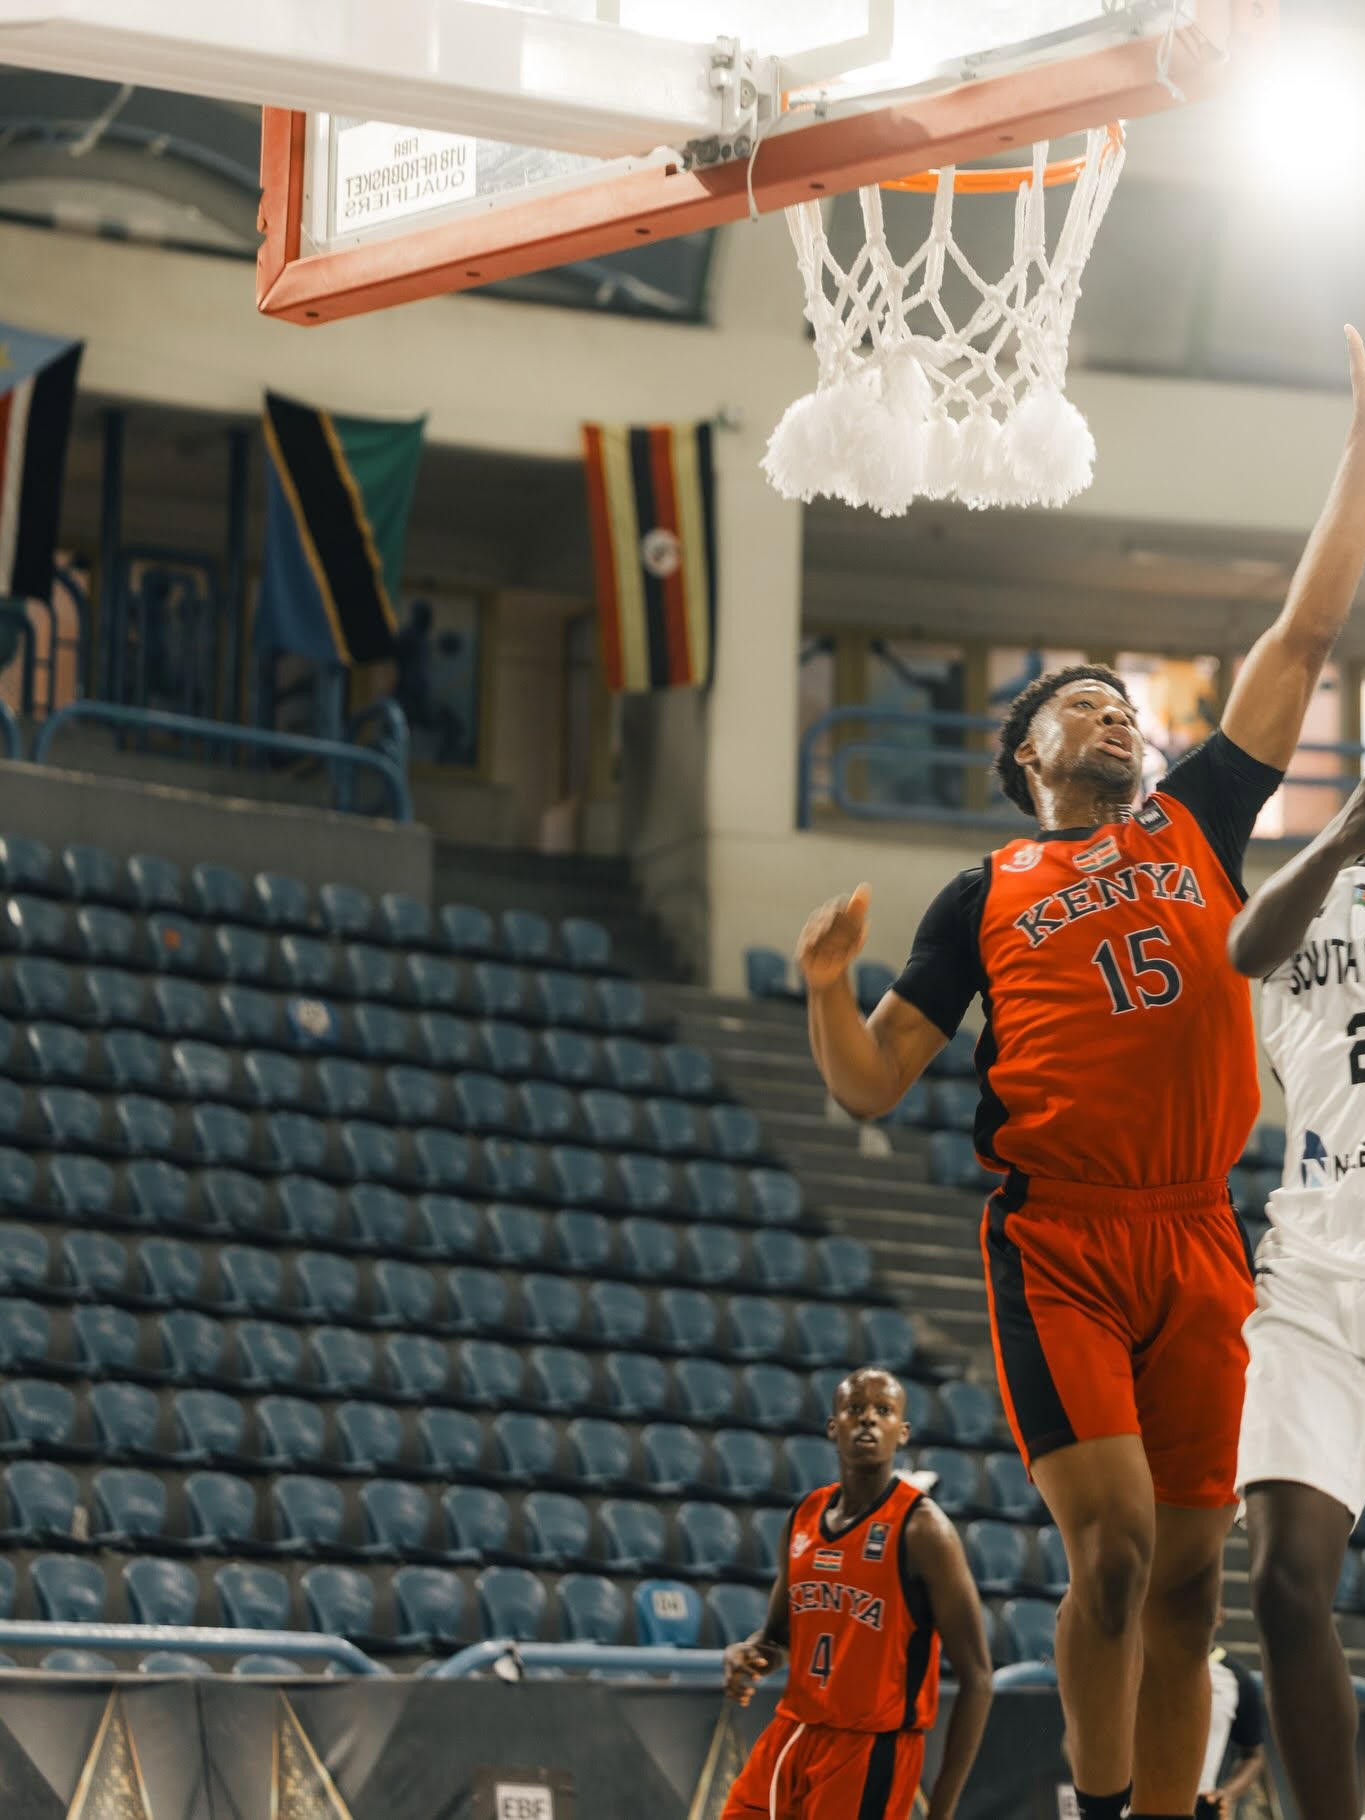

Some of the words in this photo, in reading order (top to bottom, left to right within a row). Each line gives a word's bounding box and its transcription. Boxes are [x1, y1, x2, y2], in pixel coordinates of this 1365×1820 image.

[1014, 862, 1206, 948] KENYA
[1092, 926, 1183, 1016] 15
[809, 1633, 834, 1689] 4
